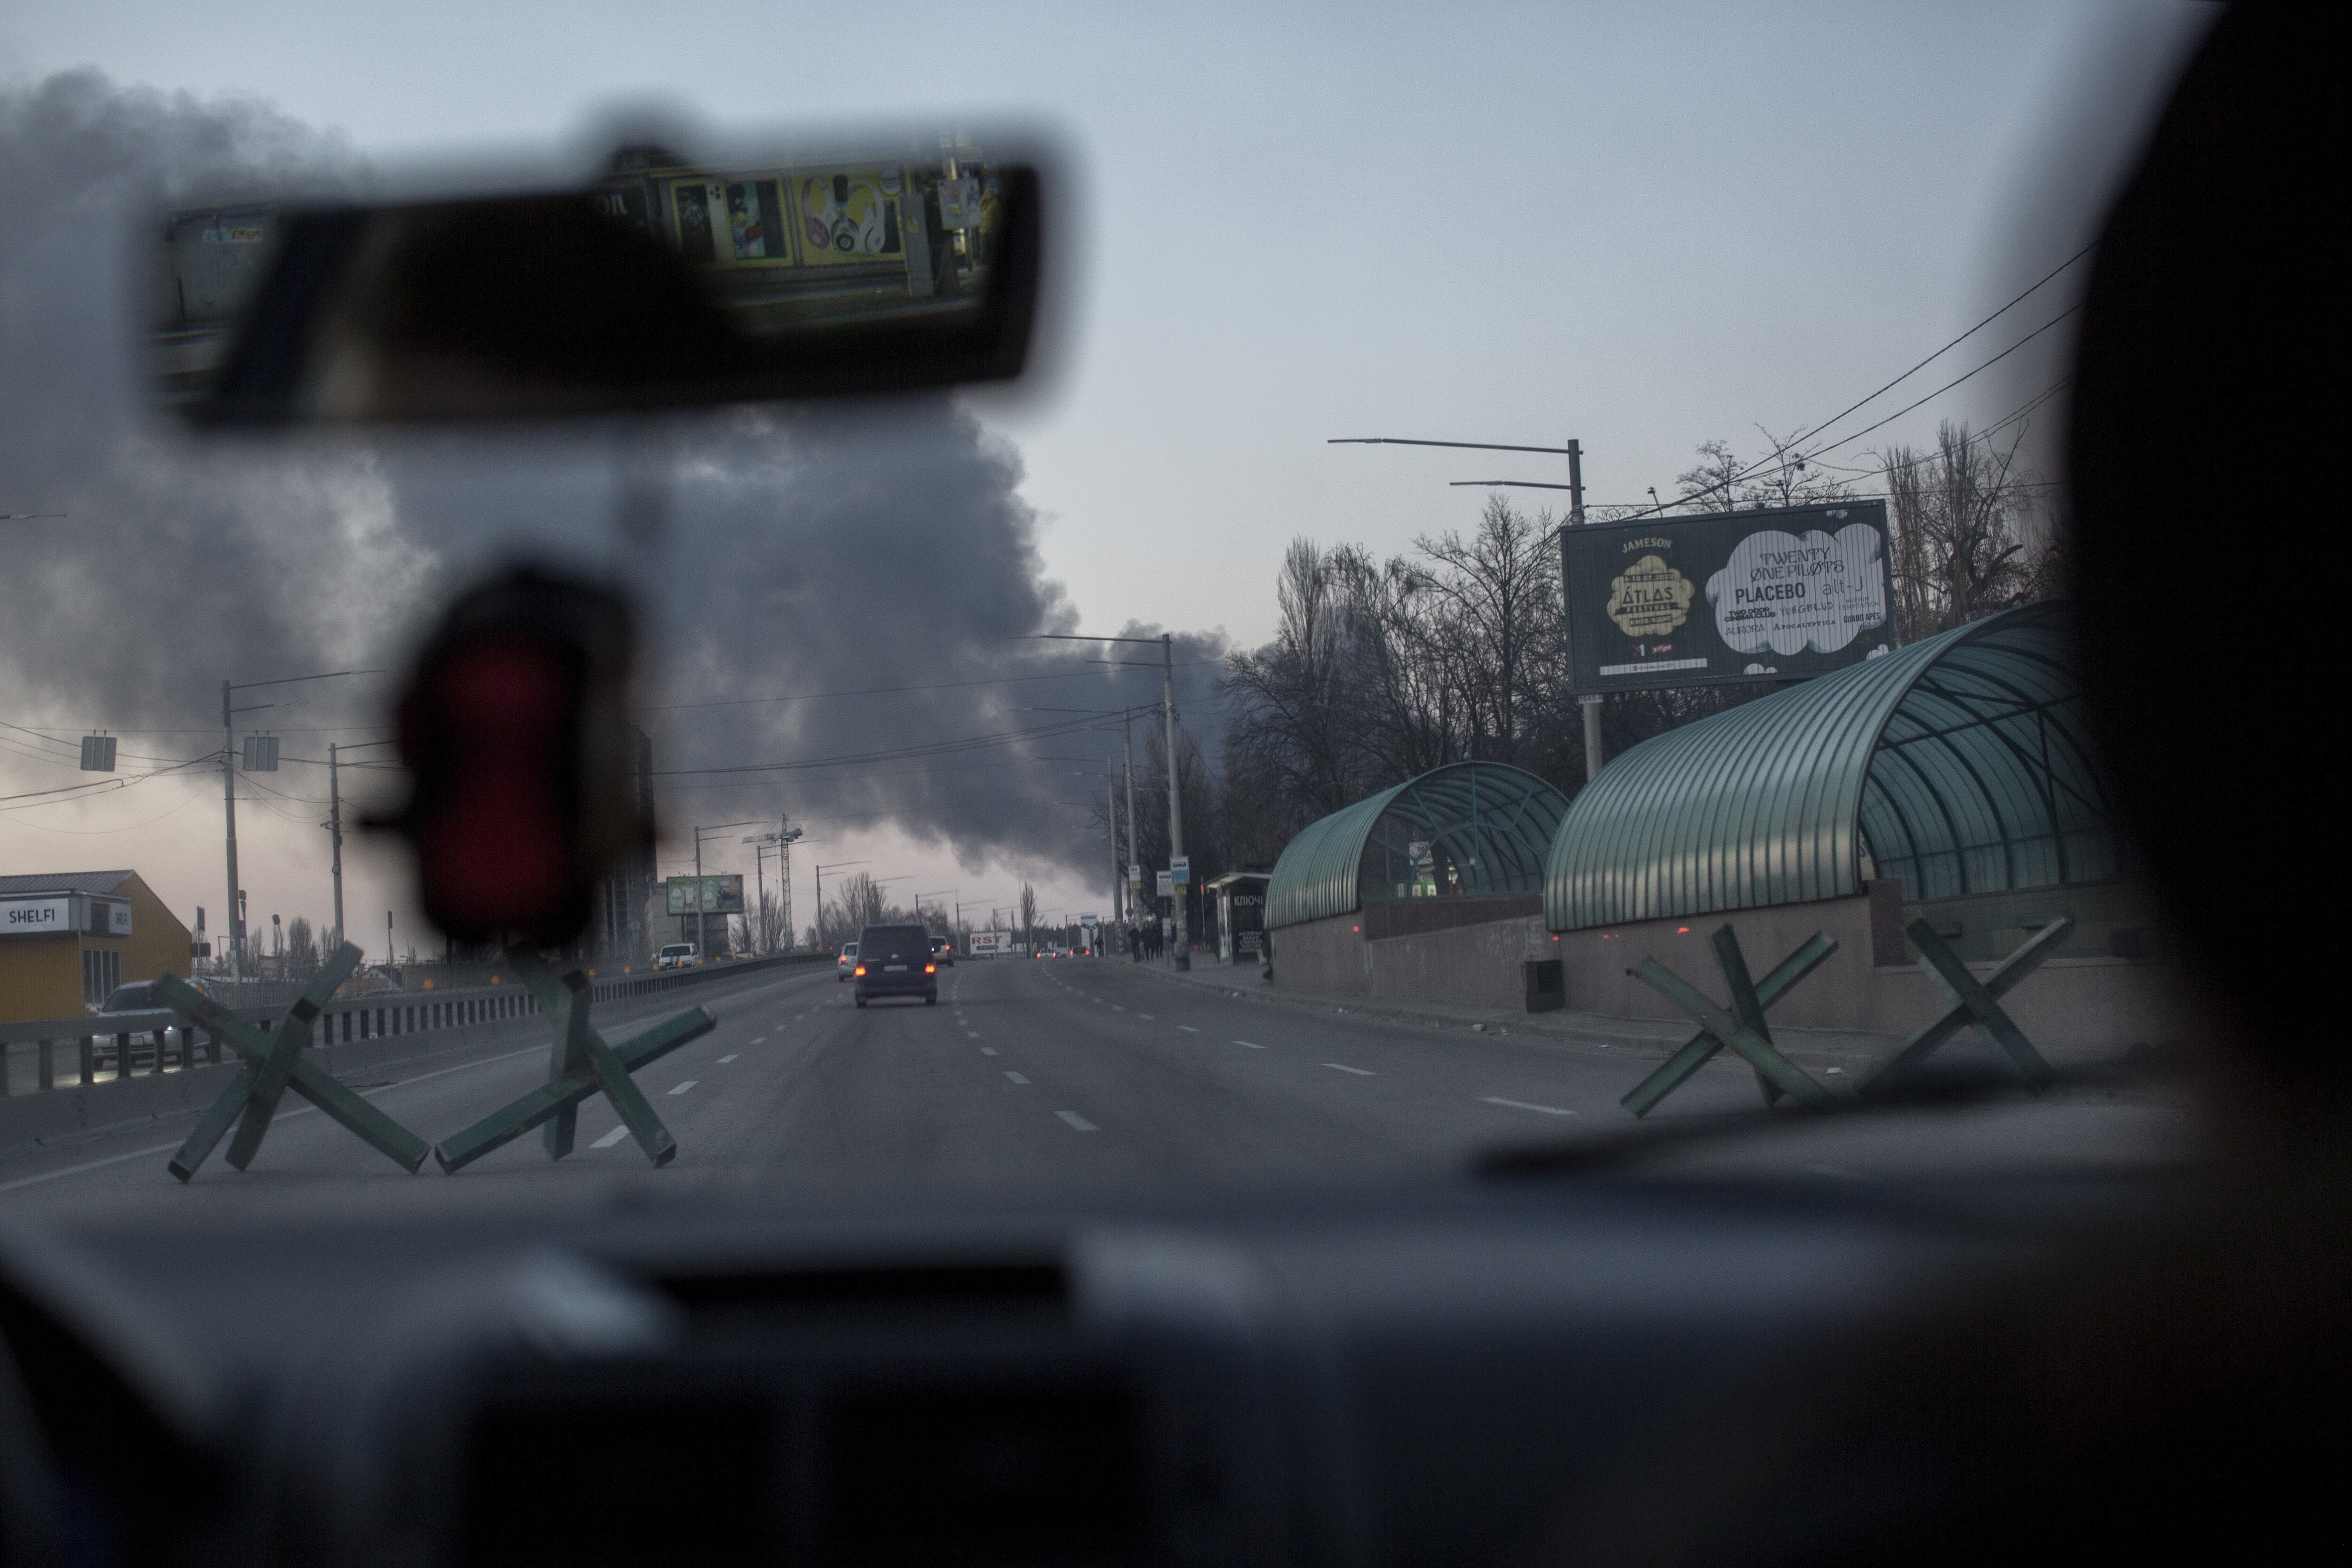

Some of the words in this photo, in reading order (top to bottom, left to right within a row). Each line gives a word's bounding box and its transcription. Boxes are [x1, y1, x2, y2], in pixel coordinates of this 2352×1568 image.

[1622, 538, 1671, 553] JAMESON
[1760, 547, 1829, 565] TWENTY
[1735, 582, 1805, 605] PLACEBO
[1823, 576, 1863, 595] alt-J
[1724, 613, 1754, 622] CINEMA
[1843, 614, 1864, 624] GUANO
[1865, 612, 1881, 621] APES
[1725, 624, 1765, 636] AURORA
[9, 908, 56, 924] SHELFI
[971, 935, 1003, 945] RST
